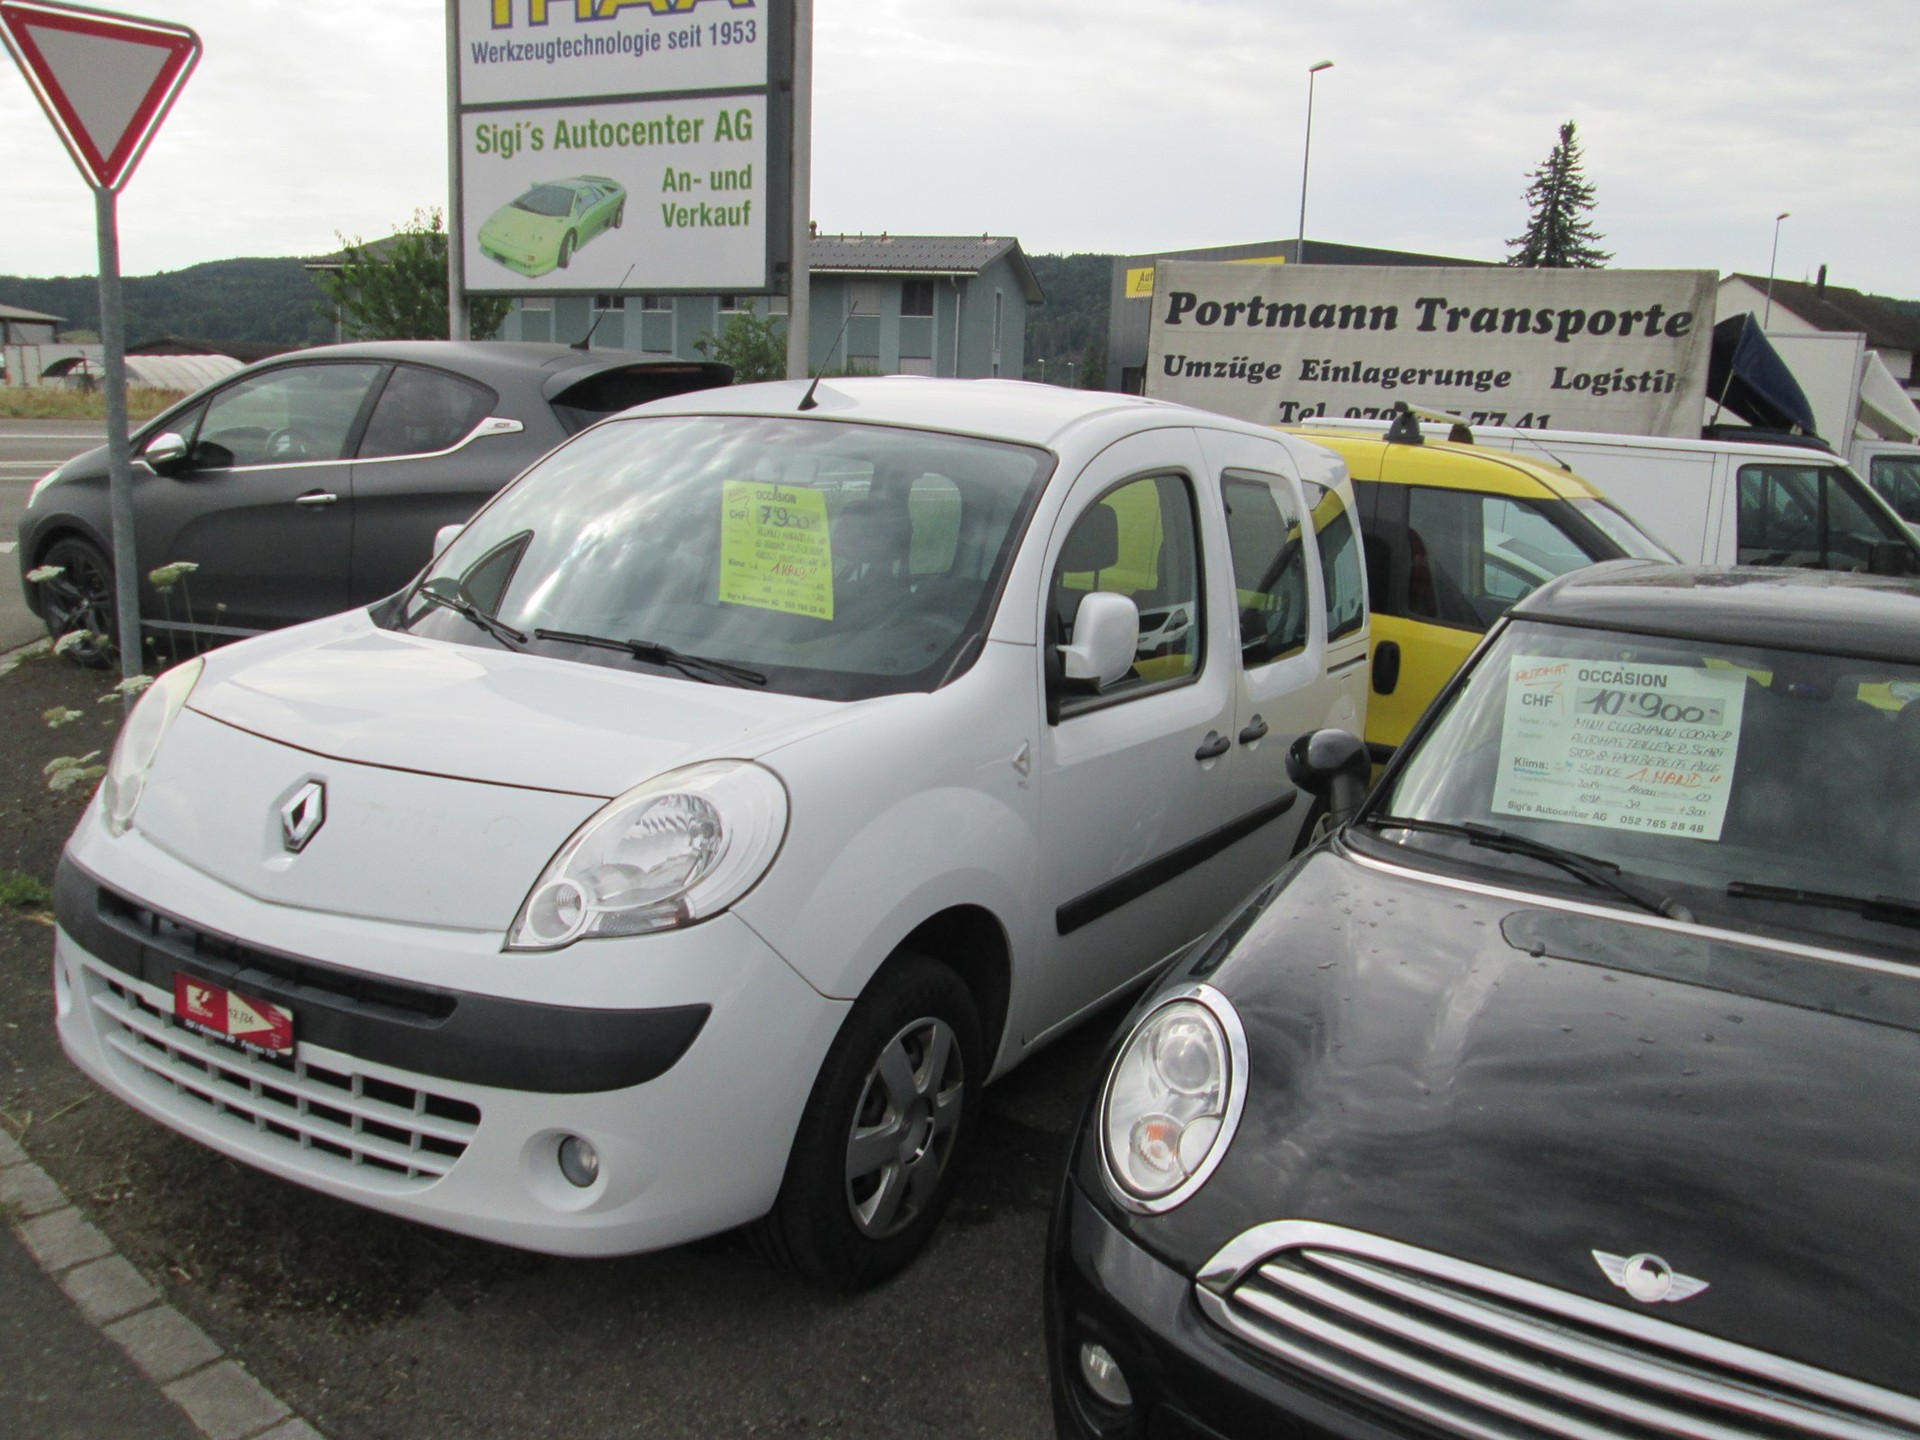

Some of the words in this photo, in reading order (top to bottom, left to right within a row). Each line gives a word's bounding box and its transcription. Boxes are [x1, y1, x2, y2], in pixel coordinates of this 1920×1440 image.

[471, 28, 661, 64] Werkzeugtechnologie
[667, 25, 702, 50] seit
[708, 19, 757, 46] 1953
[554, 114, 704, 150] Autocenter
[714, 108, 753, 142] AG
[662, 167, 702, 193] An-
[710, 164, 753, 191] und
[662, 200, 752, 229] Verkauf
[1163, 291, 1398, 331] Portmann
[1415, 297, 1693, 343] Transporte
[1163, 354, 1282, 382] Umzüge
[1299, 359, 1512, 392] Einlagerunge
[1578, 669, 1668, 688] OCCASION
[1522, 693, 1553, 708] CHF
[1514, 756, 1548, 769] Klima:
[1534, 803, 1589, 819] Autocenter
[1591, 811, 1608, 821] AG
[1619, 814, 1643, 825] 052
[1645, 817, 1667, 828] 765
[1670, 820, 1686, 831] 28
[1688, 823, 1704, 833] 48
